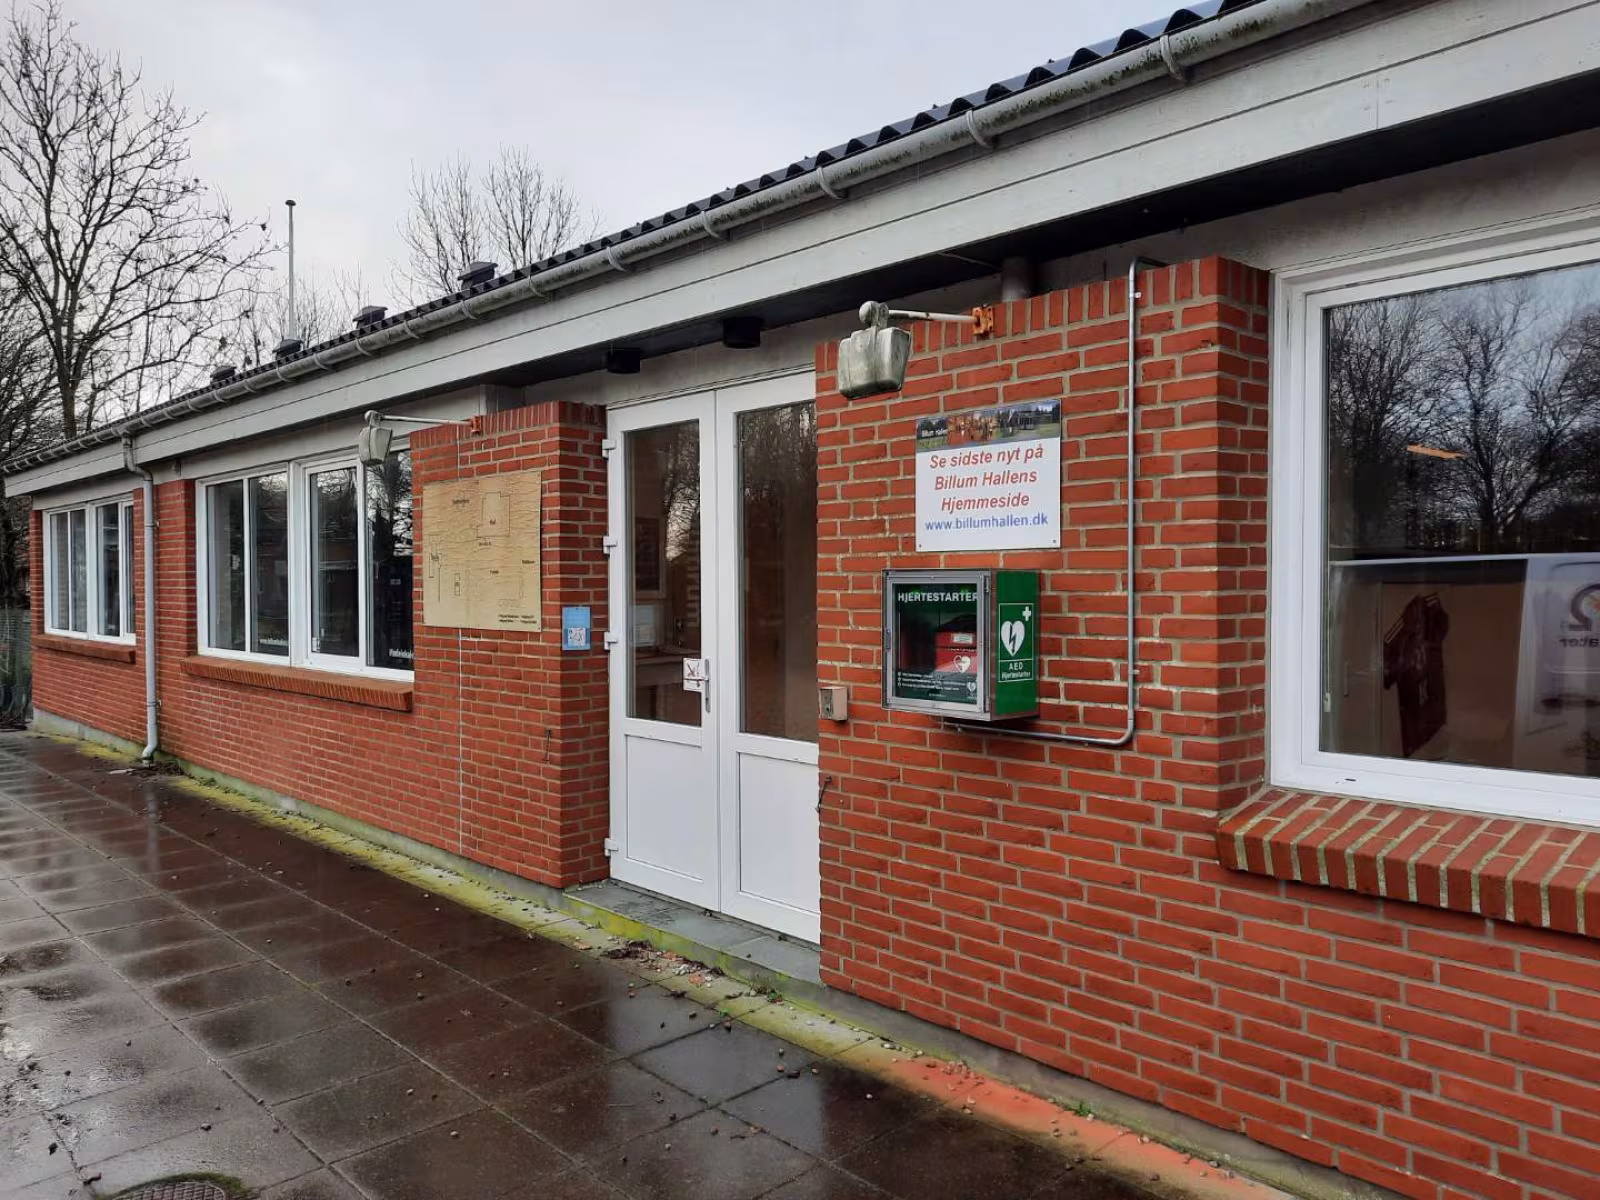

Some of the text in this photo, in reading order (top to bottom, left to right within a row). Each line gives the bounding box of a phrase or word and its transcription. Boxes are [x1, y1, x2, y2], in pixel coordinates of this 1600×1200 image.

[930, 443, 1044, 469] Se sidste nyt på
[935, 470, 1038, 491] Billum Hallens
[941, 492, 1030, 514] Hjemmeside
[925, 513, 1049, 531] www.billumhallen.dk
[898, 592, 978, 603] HJERTESTARTER
[1008, 661, 1024, 671] AED
